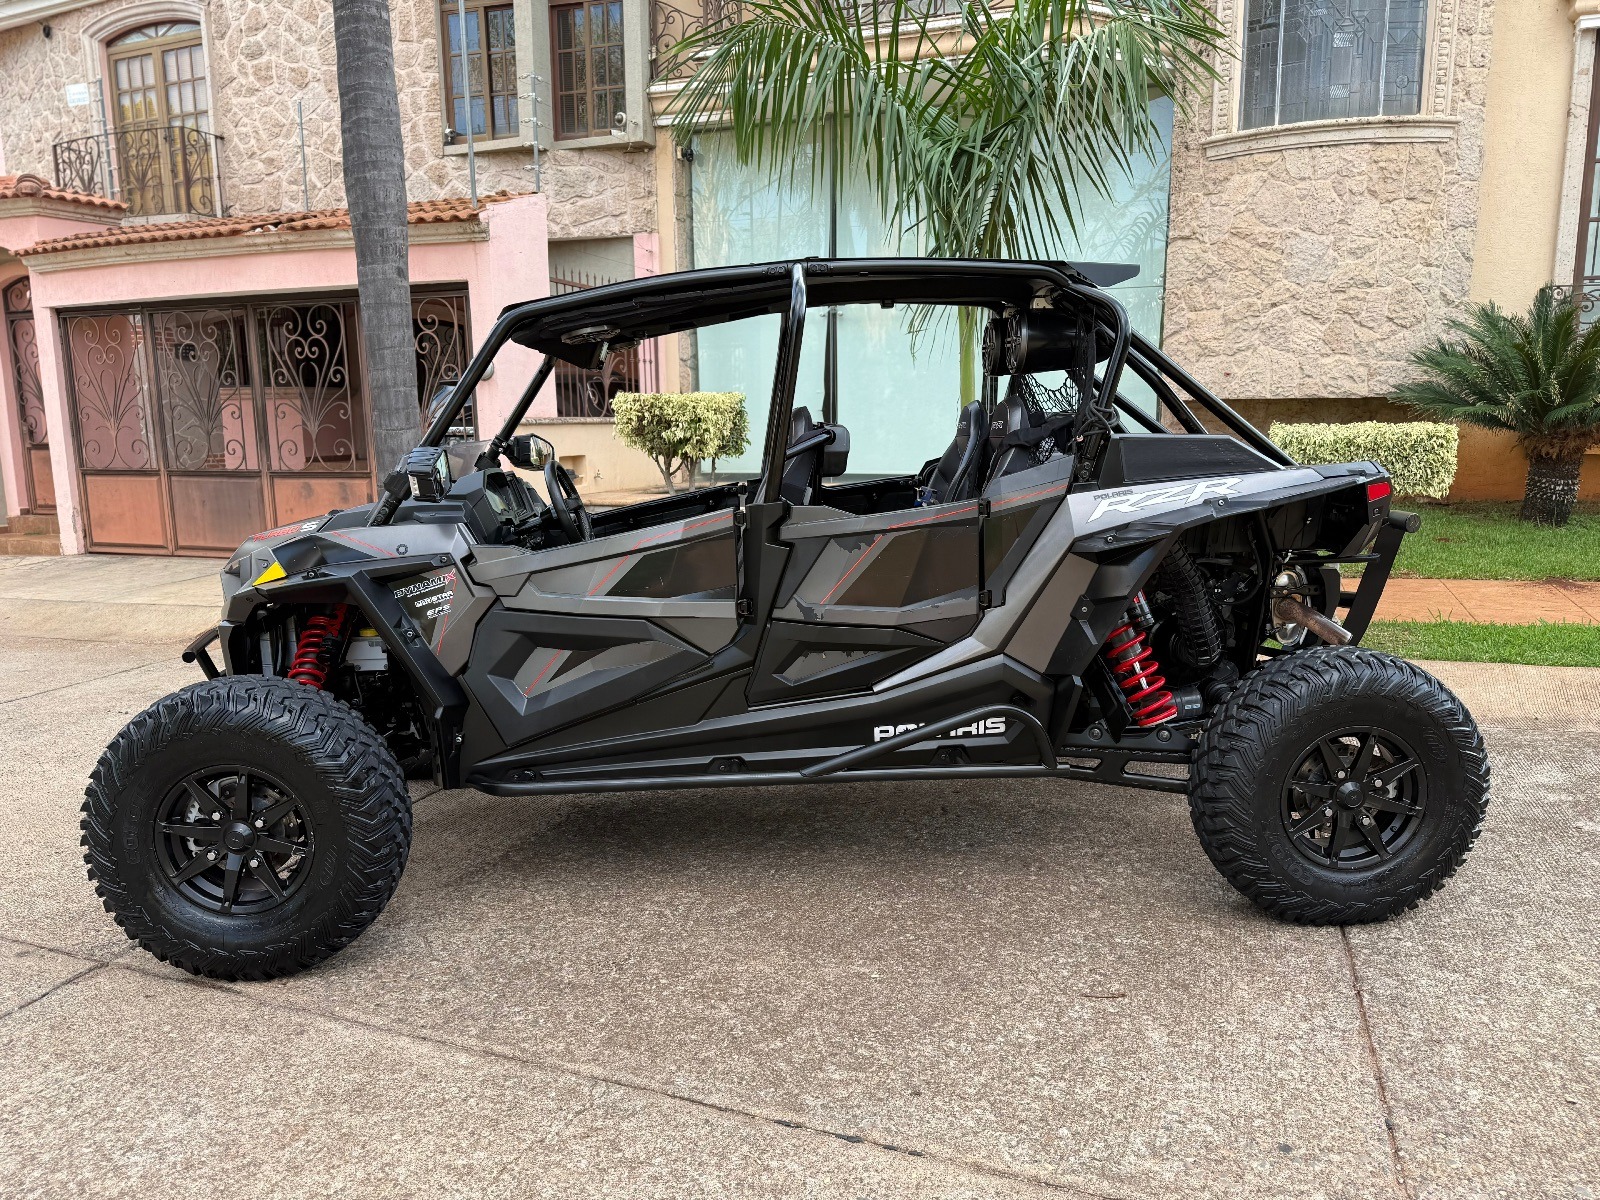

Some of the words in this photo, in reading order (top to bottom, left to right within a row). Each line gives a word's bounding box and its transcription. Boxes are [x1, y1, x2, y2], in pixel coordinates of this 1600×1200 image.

[1086, 476, 1243, 524] RZR
[1093, 488, 1134, 501] POLARIS
[253, 524, 302, 542] TURBO
[300, 520, 321, 533] S
[393, 568, 457, 599] DYNAMIX
